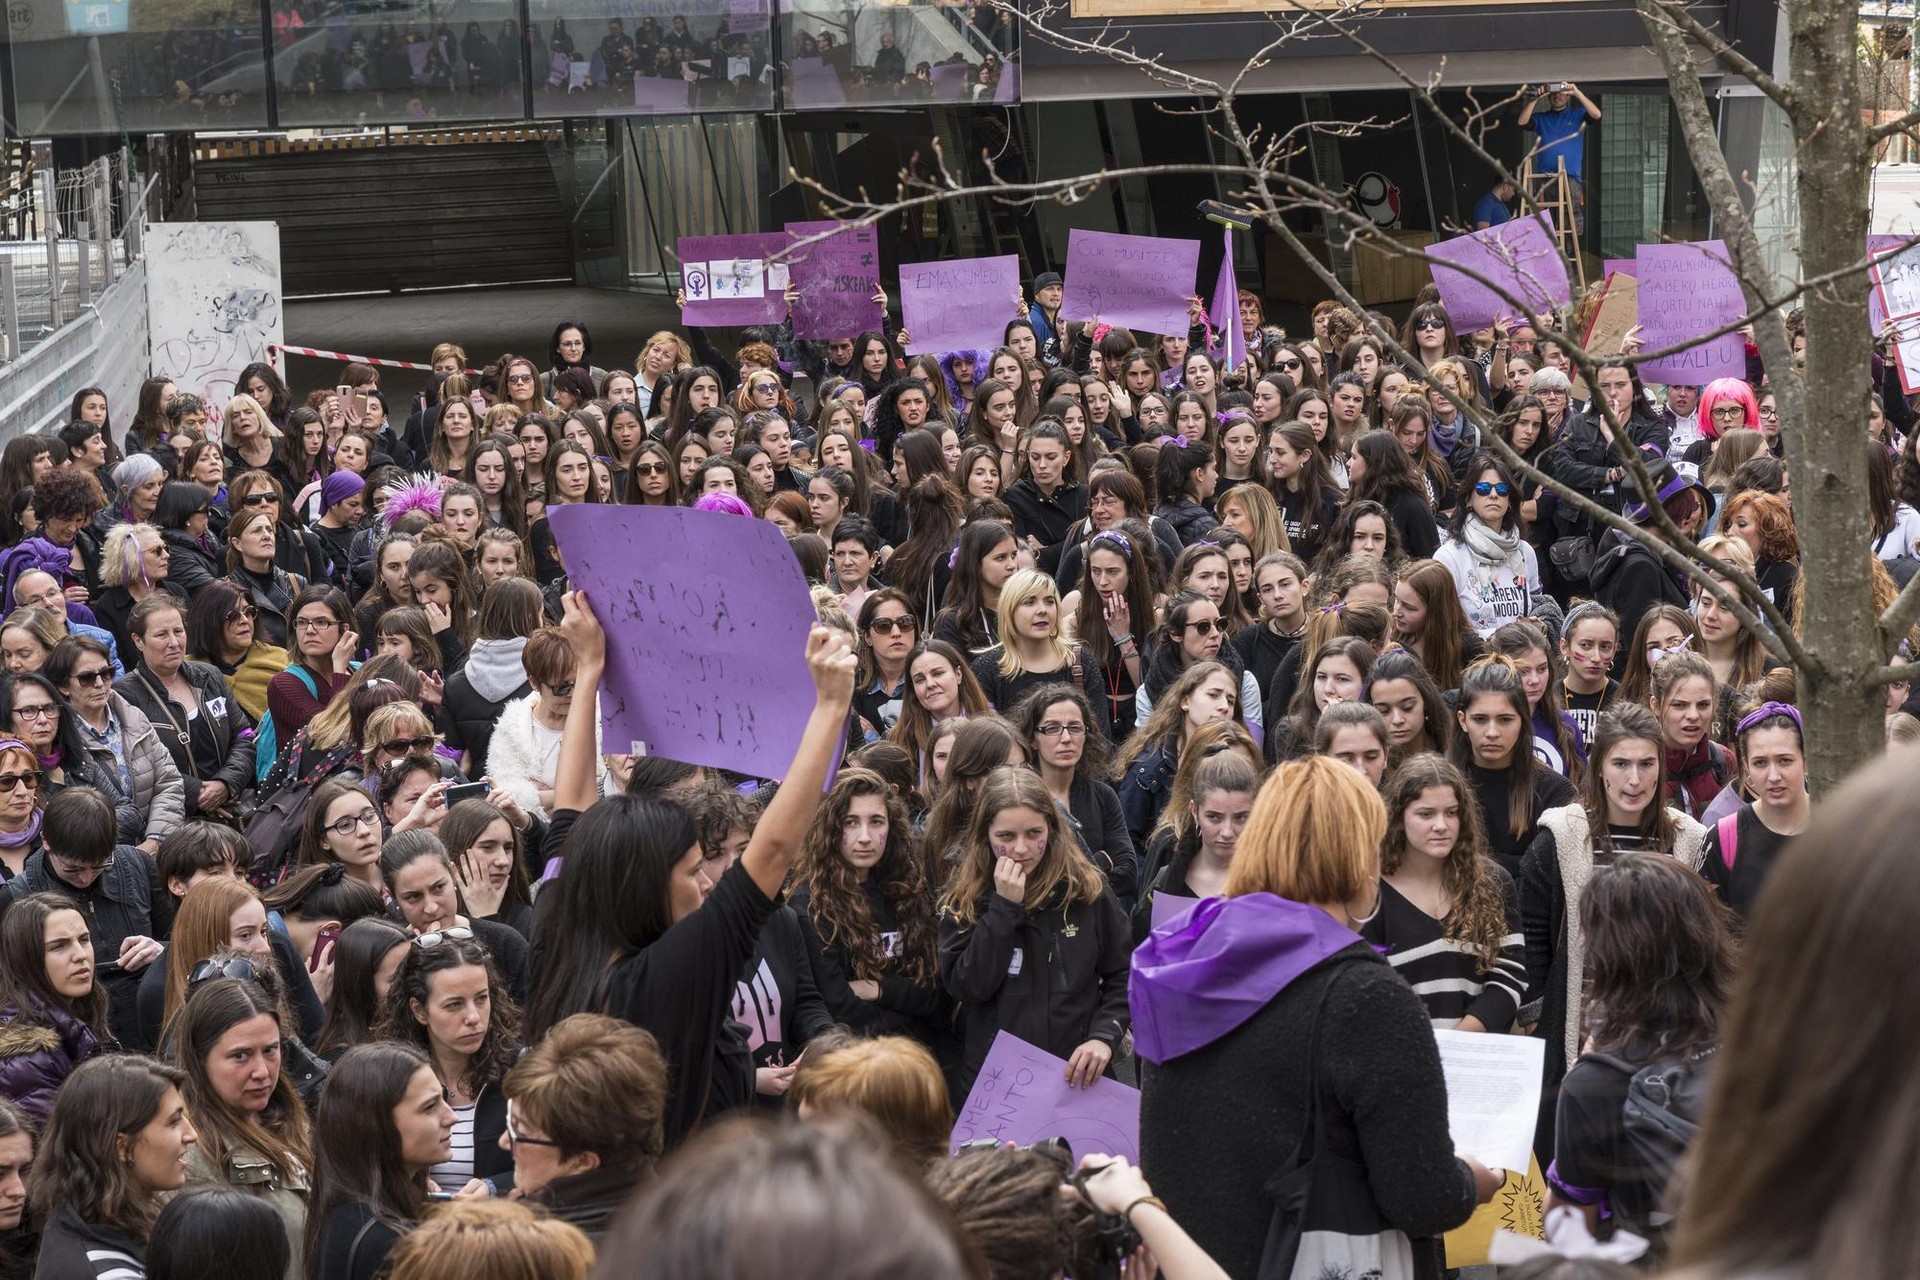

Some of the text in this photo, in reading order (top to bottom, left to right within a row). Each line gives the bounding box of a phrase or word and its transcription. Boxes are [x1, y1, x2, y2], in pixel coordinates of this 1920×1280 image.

[833, 275, 874, 293] ASKEAK
[916, 268, 1009, 292] EMAKUMEOK
[1644, 276, 1737, 295] GABEKO HERRI
[1655, 295, 1729, 313] LORTU NAHI
[1690, 317, 1715, 329] EZIN
[1493, 602, 1519, 617] MOOD
[953, 1067, 1005, 1152] UMEOK
